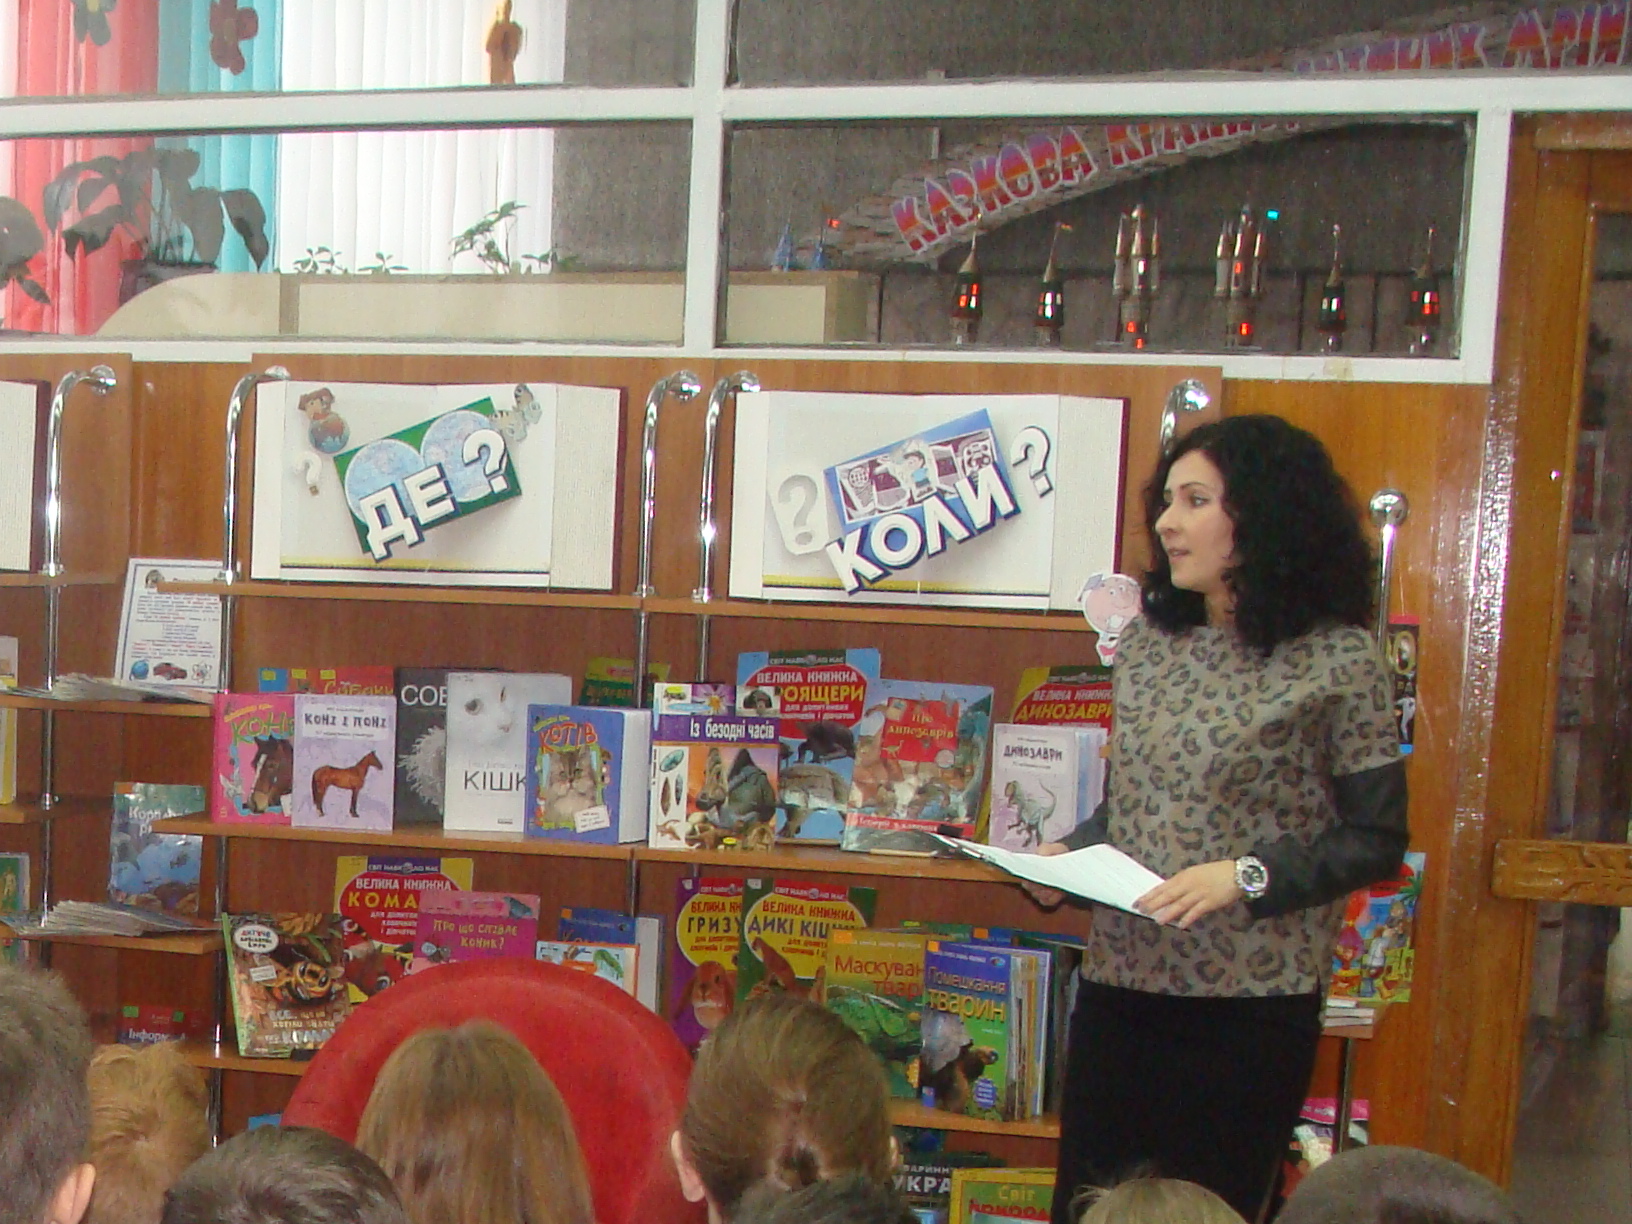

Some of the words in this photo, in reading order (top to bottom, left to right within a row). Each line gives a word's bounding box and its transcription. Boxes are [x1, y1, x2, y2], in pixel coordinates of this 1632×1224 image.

[890, 125, 1099, 253] КАЗКОВА
[401, 685, 448, 706] СОБ
[304, 713, 337, 727] КОНІ
[690, 718, 700, 736] Із
[705, 718, 746, 741] безодні
[748, 720, 775, 740] часів
[539, 722, 598, 754] КОТІВ
[1004, 745, 1063, 761] ДИНОЗАВРИ
[464, 770, 526, 791] КІШК
[348, 892, 418, 908] КОМА
[433, 919, 455, 932] ПРО
[478, 925, 518, 936] СПІВАЄ
[748, 916, 794, 935] ДИКІ
[461, 936, 505, 949] КОНИК?
[835, 955, 925, 979] Маскуван
[874, 980, 924, 1000] твар
[928, 966, 1006, 994] Помешкання
[928, 988, 1006, 1024] тварин
[893, 1176, 951, 1194] УКРА
